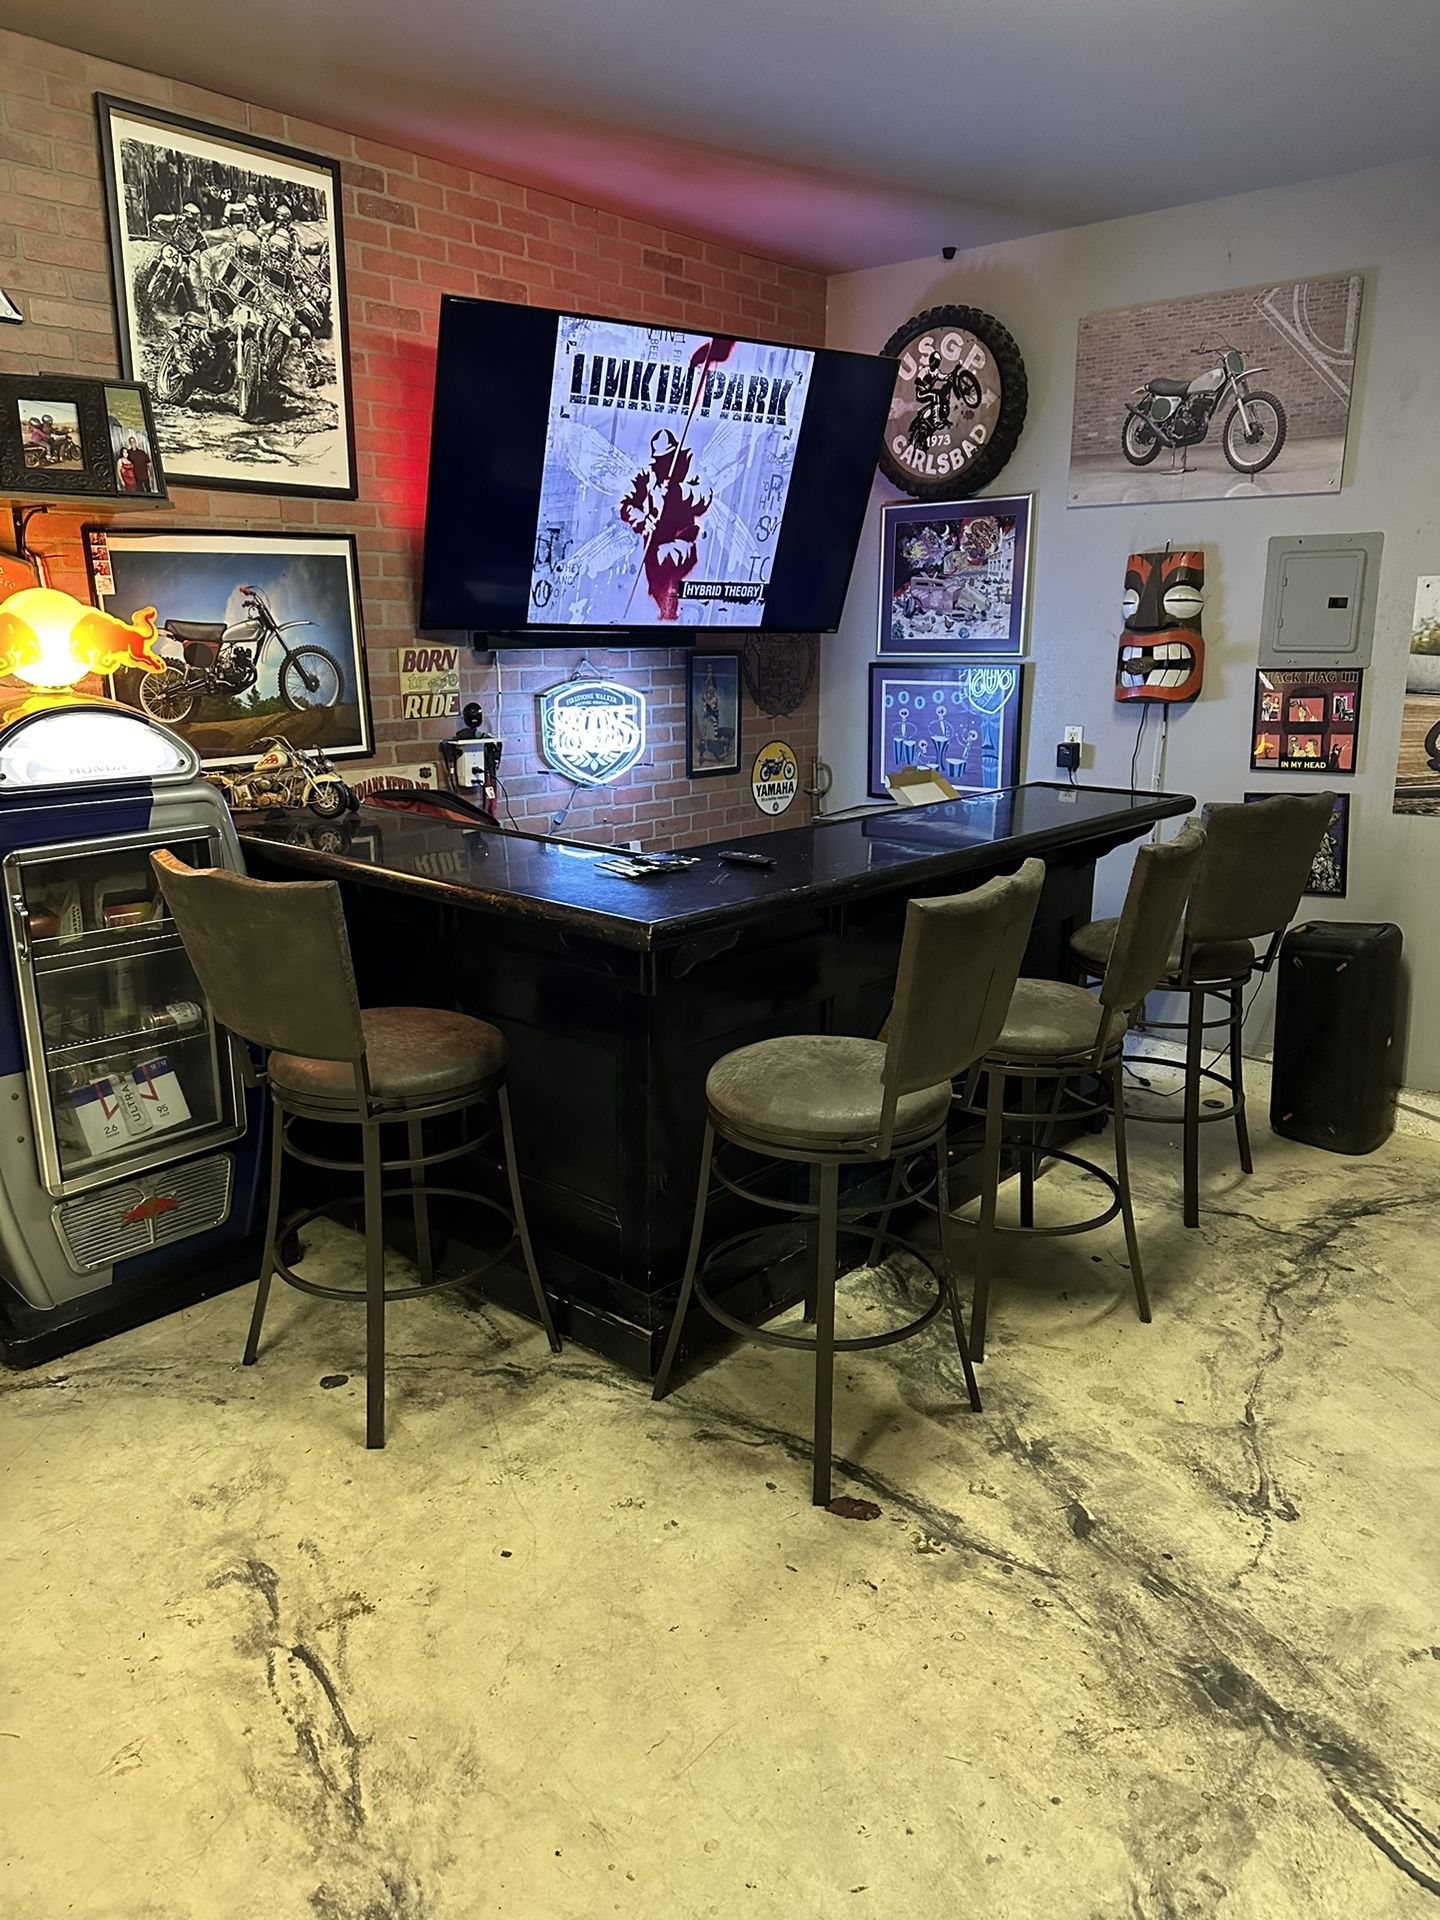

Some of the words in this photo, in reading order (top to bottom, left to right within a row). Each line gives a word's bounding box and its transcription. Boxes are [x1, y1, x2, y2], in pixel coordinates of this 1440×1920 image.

[569, 353, 694, 416] LINKIN
[700, 370, 794, 426] PARK
[892, 423, 988, 475] CARLSBAD
[926, 434, 951, 448] 1973
[402, 648, 458, 673] BORN
[407, 673, 428, 689] to
[1260, 670, 1301, 684] LACK
[1305, 671, 1337, 684] FLAG
[404, 693, 459, 719] RIDE
[1304, 761, 1326, 769] HEAD
[756, 781, 794, 797] YAMAHA
[121, 1084, 142, 1122] ULTRA
[156, 1103, 169, 1114] 95
[103, 1123, 118, 1135] 2.6
